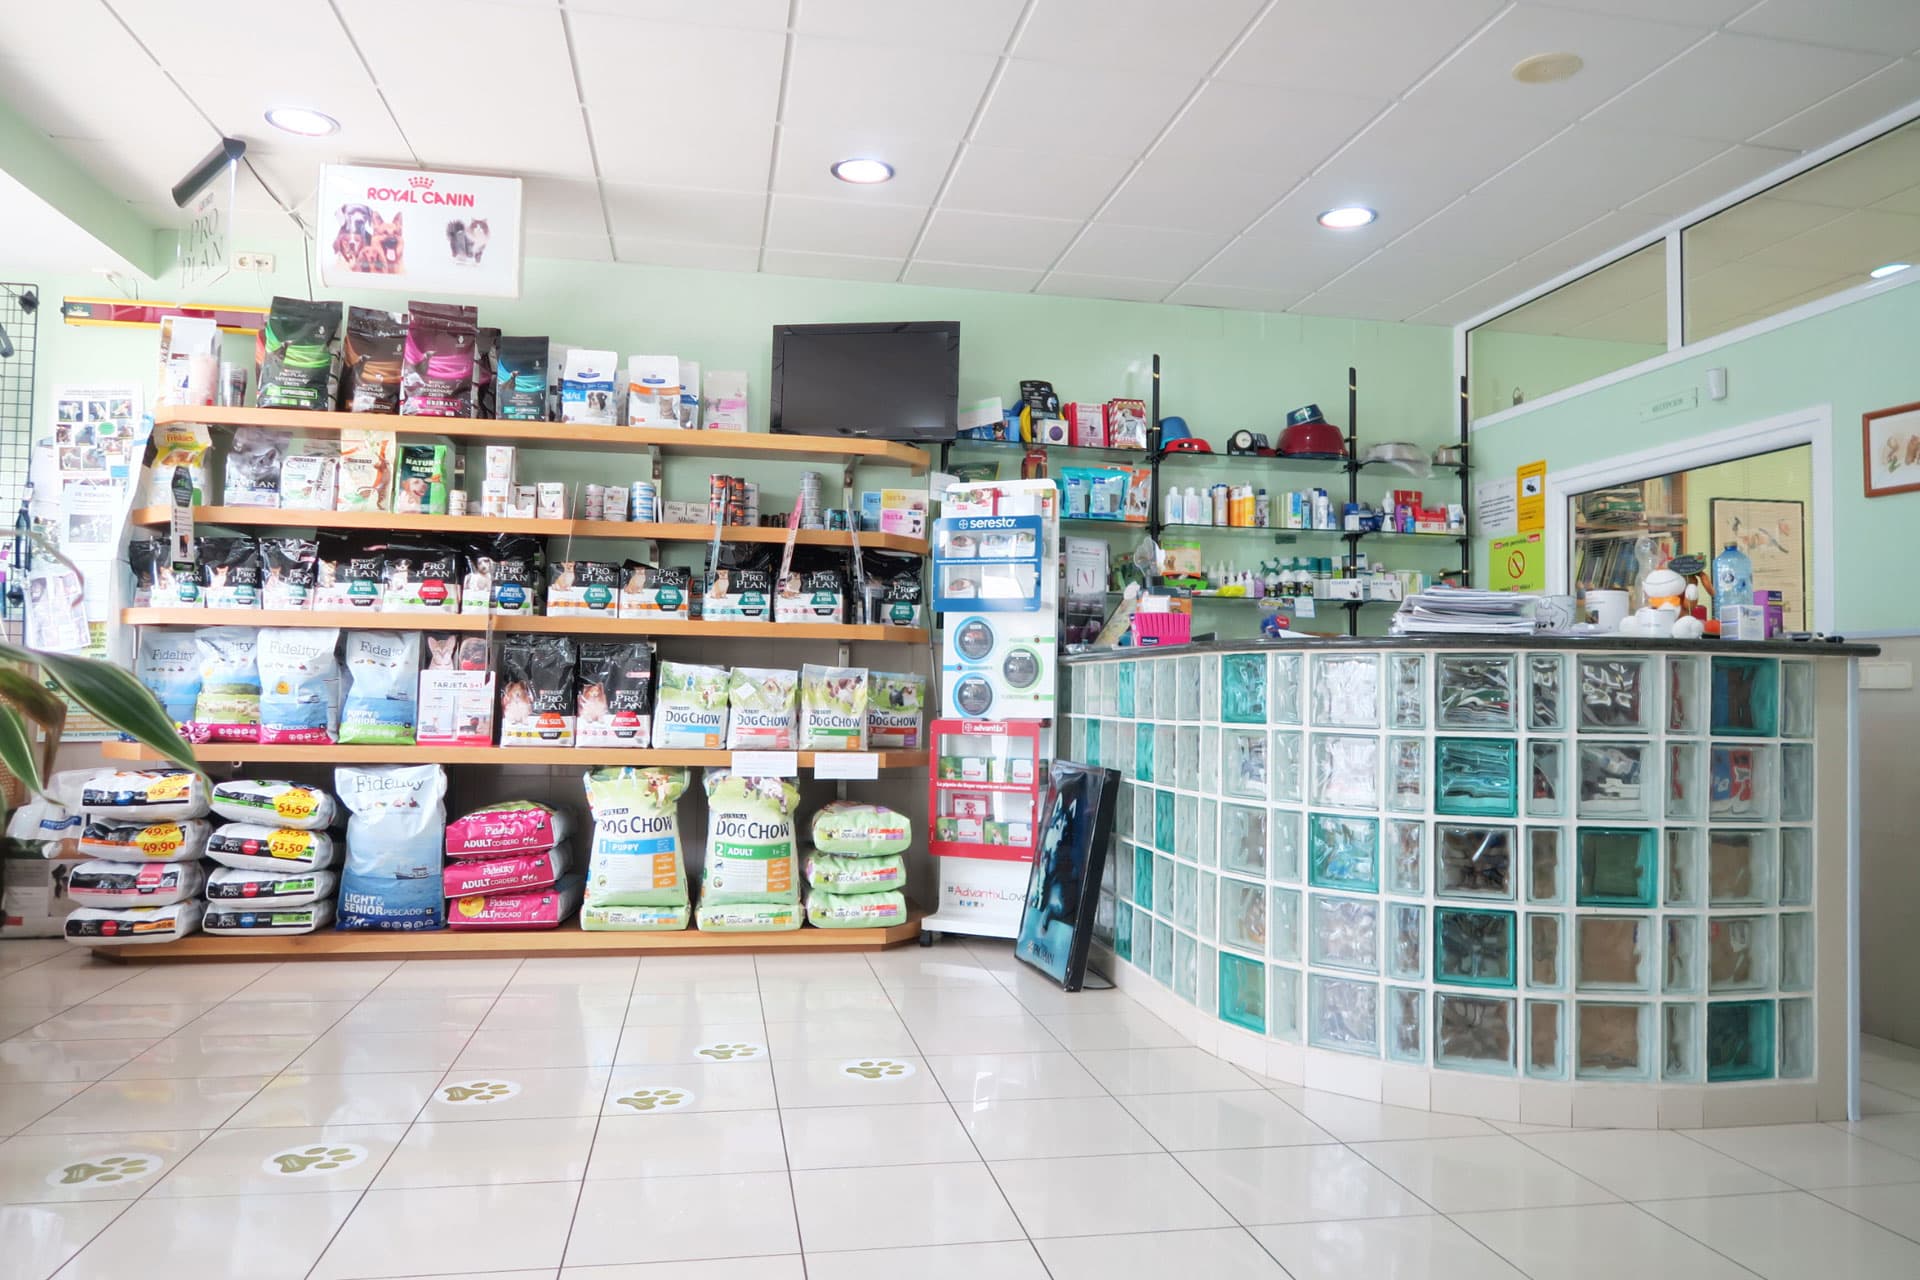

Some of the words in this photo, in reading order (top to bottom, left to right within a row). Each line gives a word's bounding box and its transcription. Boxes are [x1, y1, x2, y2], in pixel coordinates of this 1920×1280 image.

[367, 187, 418, 203] ROYAL
[422, 192, 475, 207] CANIN
[190, 208, 219, 252] PRO
[970, 517, 1015, 528] seresto
[351, 561, 376, 569] PRO
[500, 565, 524, 574] PRO
[344, 568, 380, 578] PLAN
[416, 569, 450, 577] PLAN
[587, 567, 610, 575] PRO
[658, 569, 679, 577] PRO
[495, 573, 529, 581] PLAN
[582, 574, 614, 582] PLAN
[652, 575, 684, 584] PLAN
[741, 572, 764, 581] PRO
[813, 573, 834, 581] PRO
[736, 580, 767, 589] PLAN
[808, 579, 838, 588] PLAN
[893, 585, 914, 593] PRO
[888, 591, 918, 600] PLAN
[270, 640, 320, 657] Fidelity
[152, 649, 193, 662] Fidelity
[539, 694, 563, 702] PRO
[615, 694, 638, 702] PRO
[533, 702, 567, 710] PLAN
[609, 701, 643, 710] PLAN
[665, 711, 688, 723] DOG
[689, 712, 721, 724] CHOW
[737, 714, 758, 726] DOG
[759, 715, 790, 727] CHOW
[809, 714, 831, 726] DOG
[831, 715, 860, 727] CHOW
[869, 714, 889, 726] DOG
[891, 716, 917, 727] CHOW
[356, 775, 424, 793] Fidelity
[630, 816, 673, 833] CHOW
[716, 821, 746, 838] DOG
[748, 822, 790, 839] CHOW
[271, 841, 303, 853] 51,50
[464, 839, 492, 848] ADULT
[612, 843, 640, 851] PUPPY
[716, 844, 724, 856] 2
[483, 864, 515, 876] Fidelity
[462, 879, 490, 890] ADULT
[345, 892, 376, 905] LIGHT
[344, 903, 383, 915] SENIOR
[384, 908, 422, 916] PESCADO
